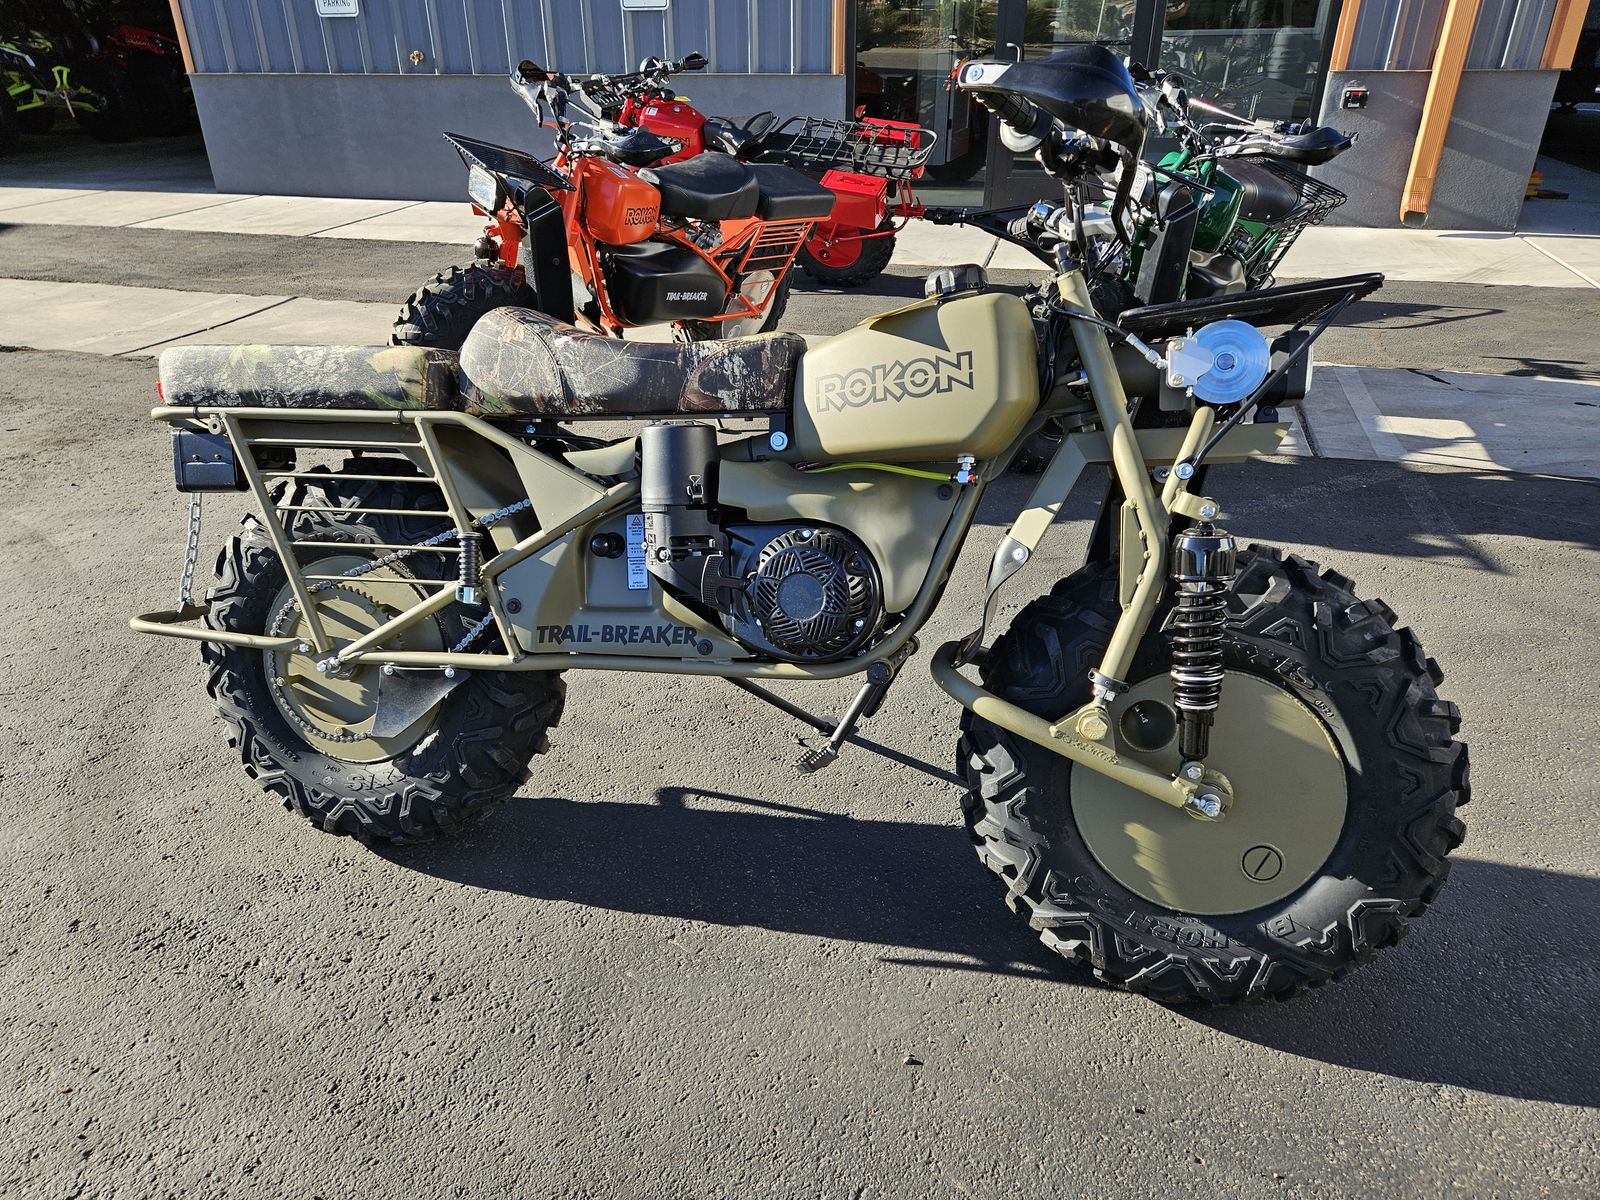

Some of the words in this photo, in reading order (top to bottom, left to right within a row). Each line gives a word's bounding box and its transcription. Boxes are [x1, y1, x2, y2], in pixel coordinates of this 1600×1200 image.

[625, 205, 659, 225] ROKON
[666, 291, 708, 301] TRAIL-BREAKER
[816, 350, 974, 413] ROKON
[536, 623, 699, 648] TRAIL-BREAKER
